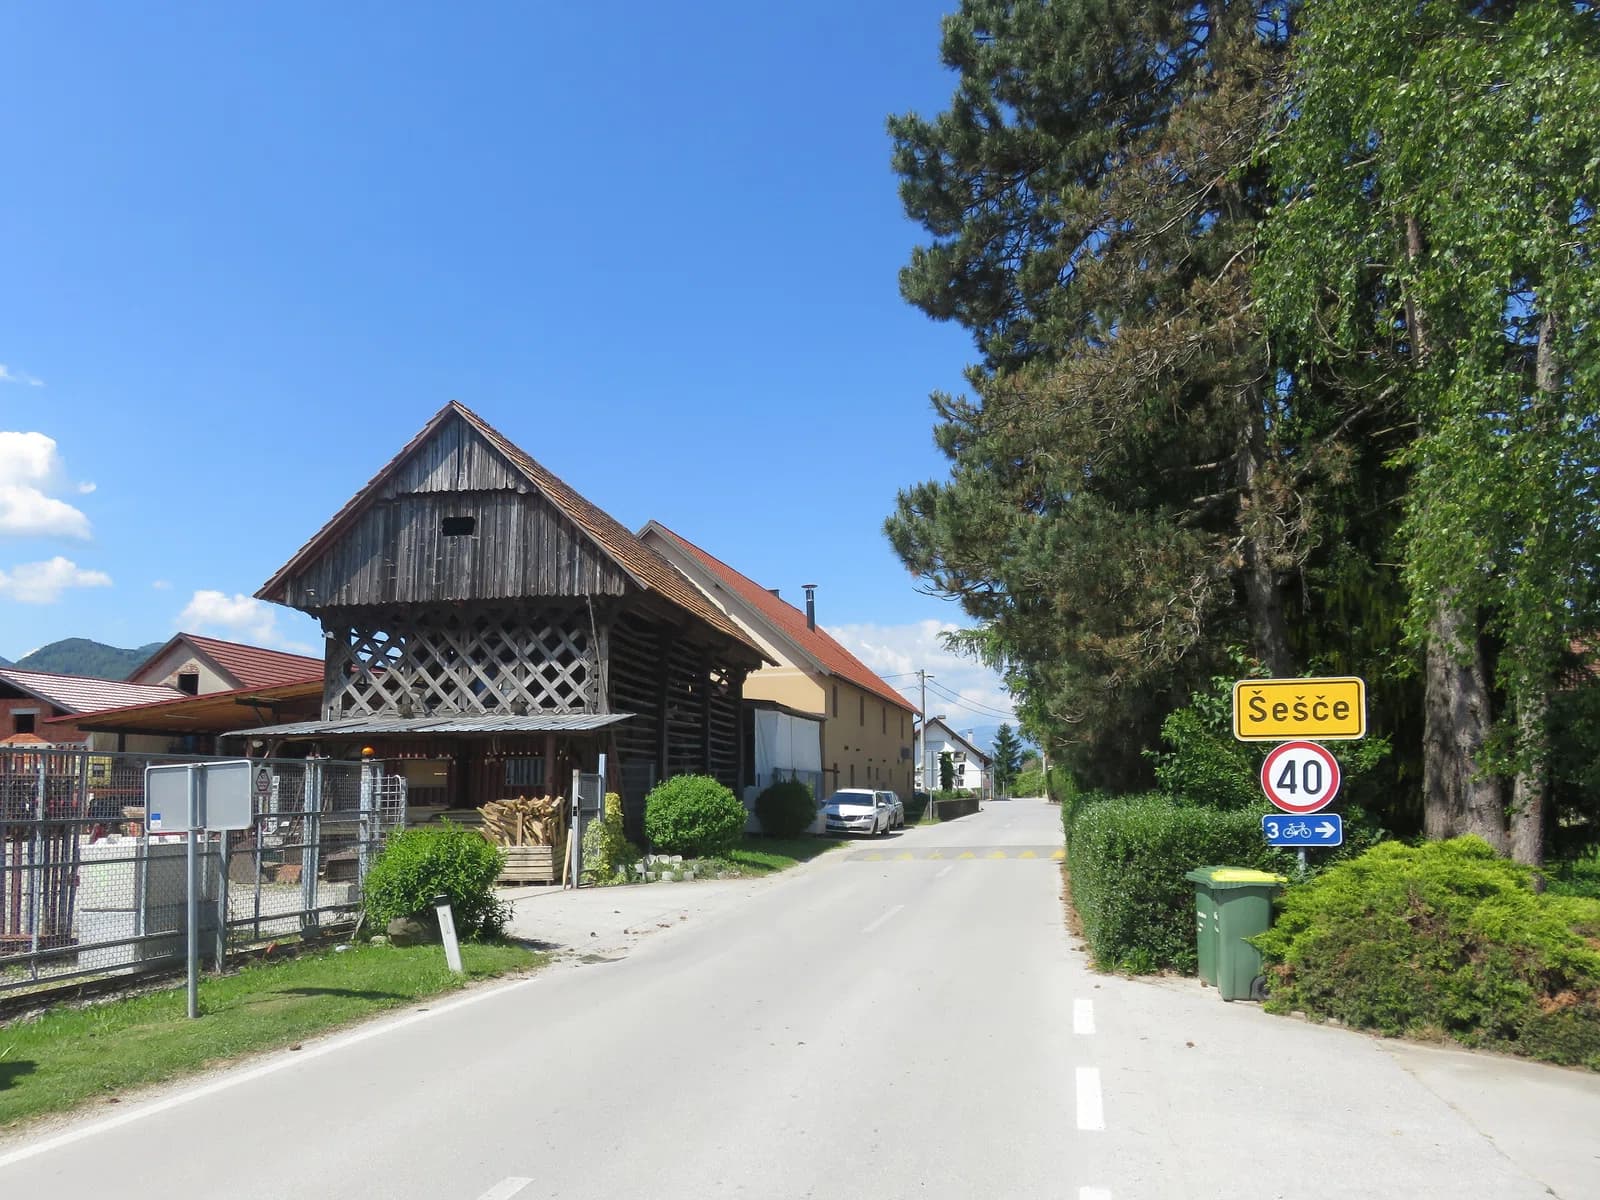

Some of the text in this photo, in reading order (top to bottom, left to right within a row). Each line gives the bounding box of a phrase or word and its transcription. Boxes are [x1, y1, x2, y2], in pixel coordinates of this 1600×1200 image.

[1249, 690, 1350, 722] Šešče
[1276, 760, 1322, 795] 40
[1267, 822, 1280, 839] 3
